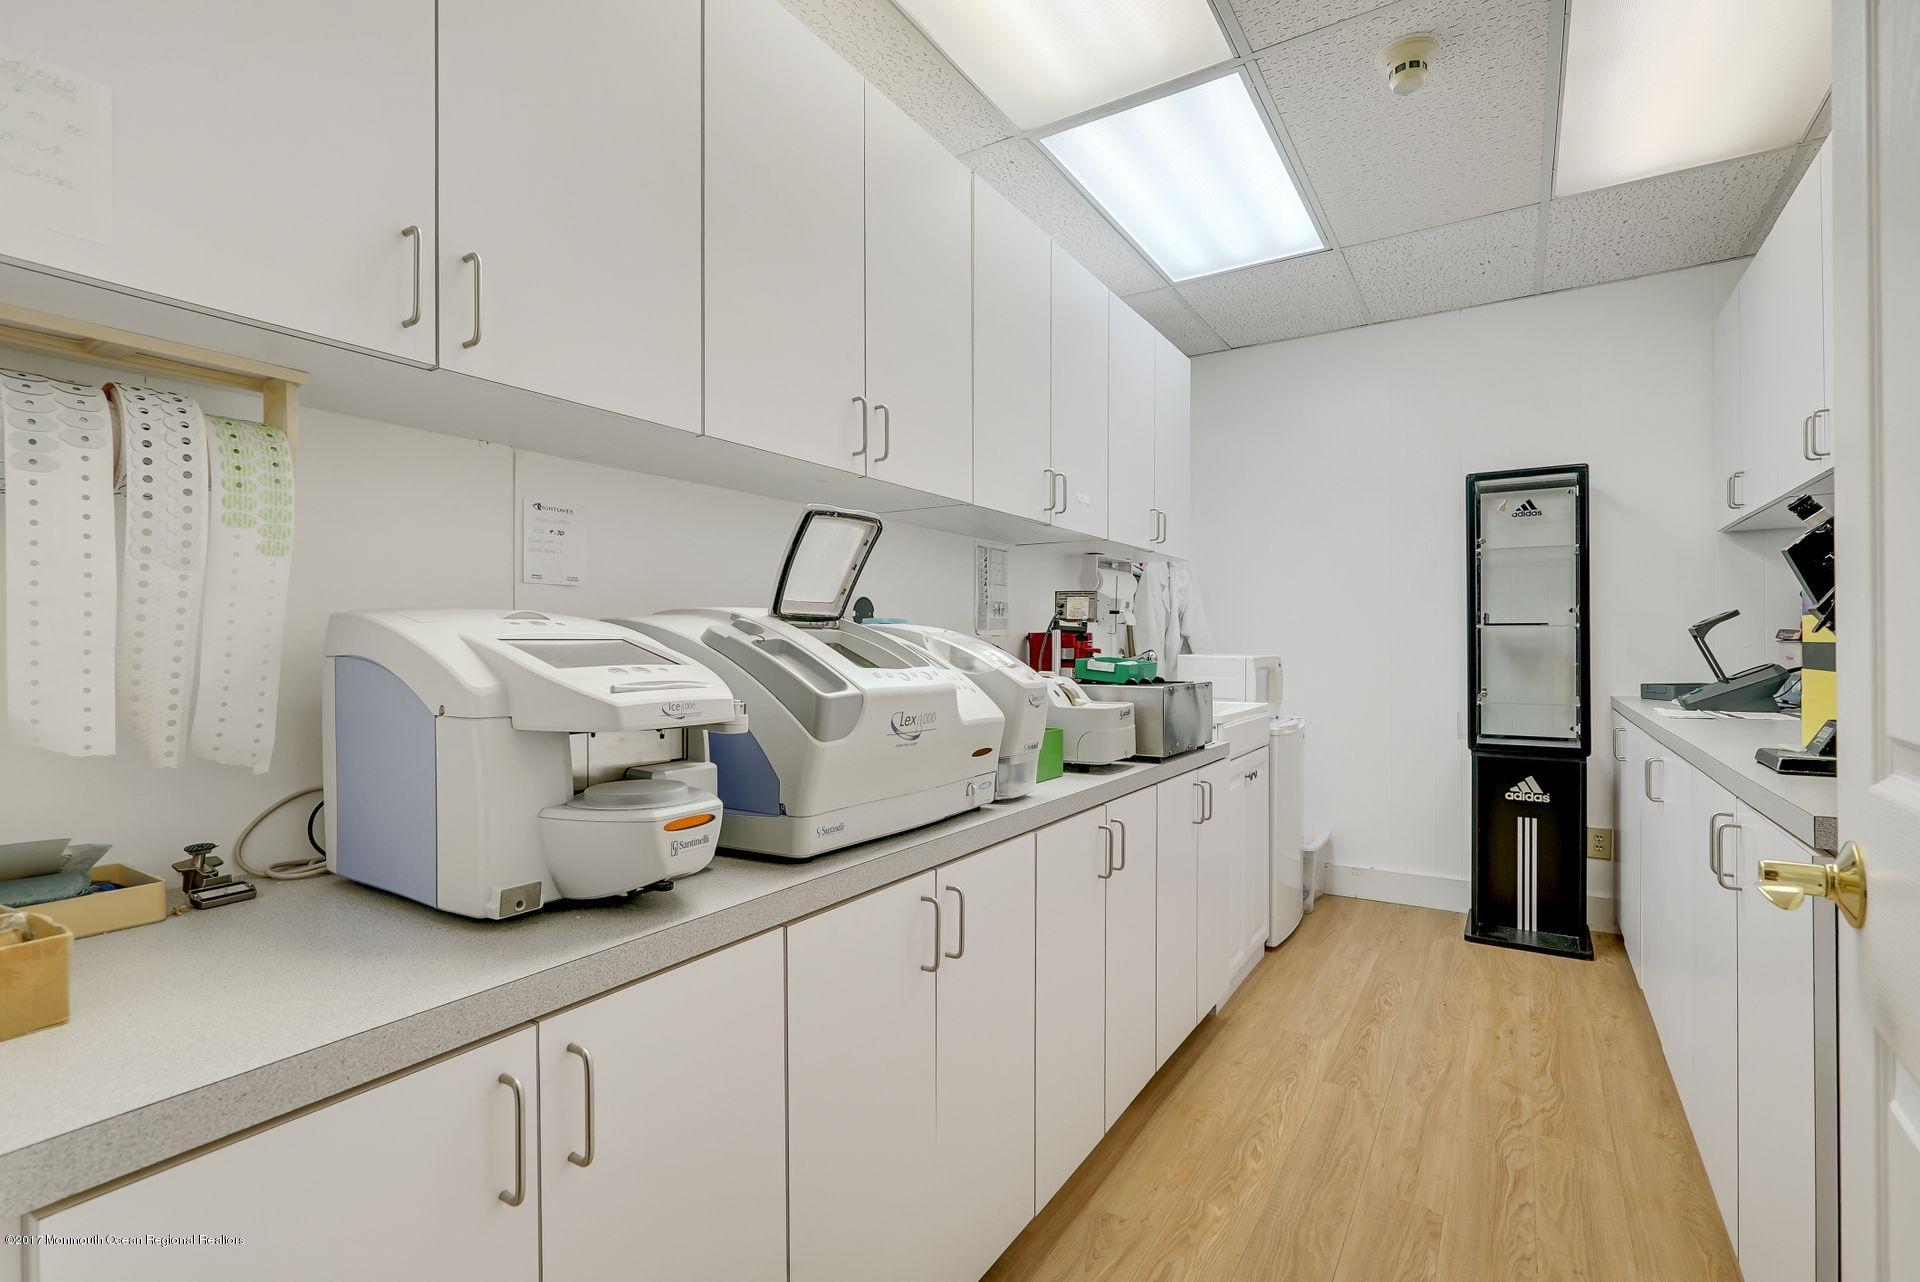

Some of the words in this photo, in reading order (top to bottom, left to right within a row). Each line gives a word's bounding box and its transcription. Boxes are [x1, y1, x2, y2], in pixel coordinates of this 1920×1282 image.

[1511, 509, 1543, 518] adidas
[668, 701, 681, 712] Ice
[899, 711, 917, 727] Lex
[1504, 790, 1551, 803] adidas
